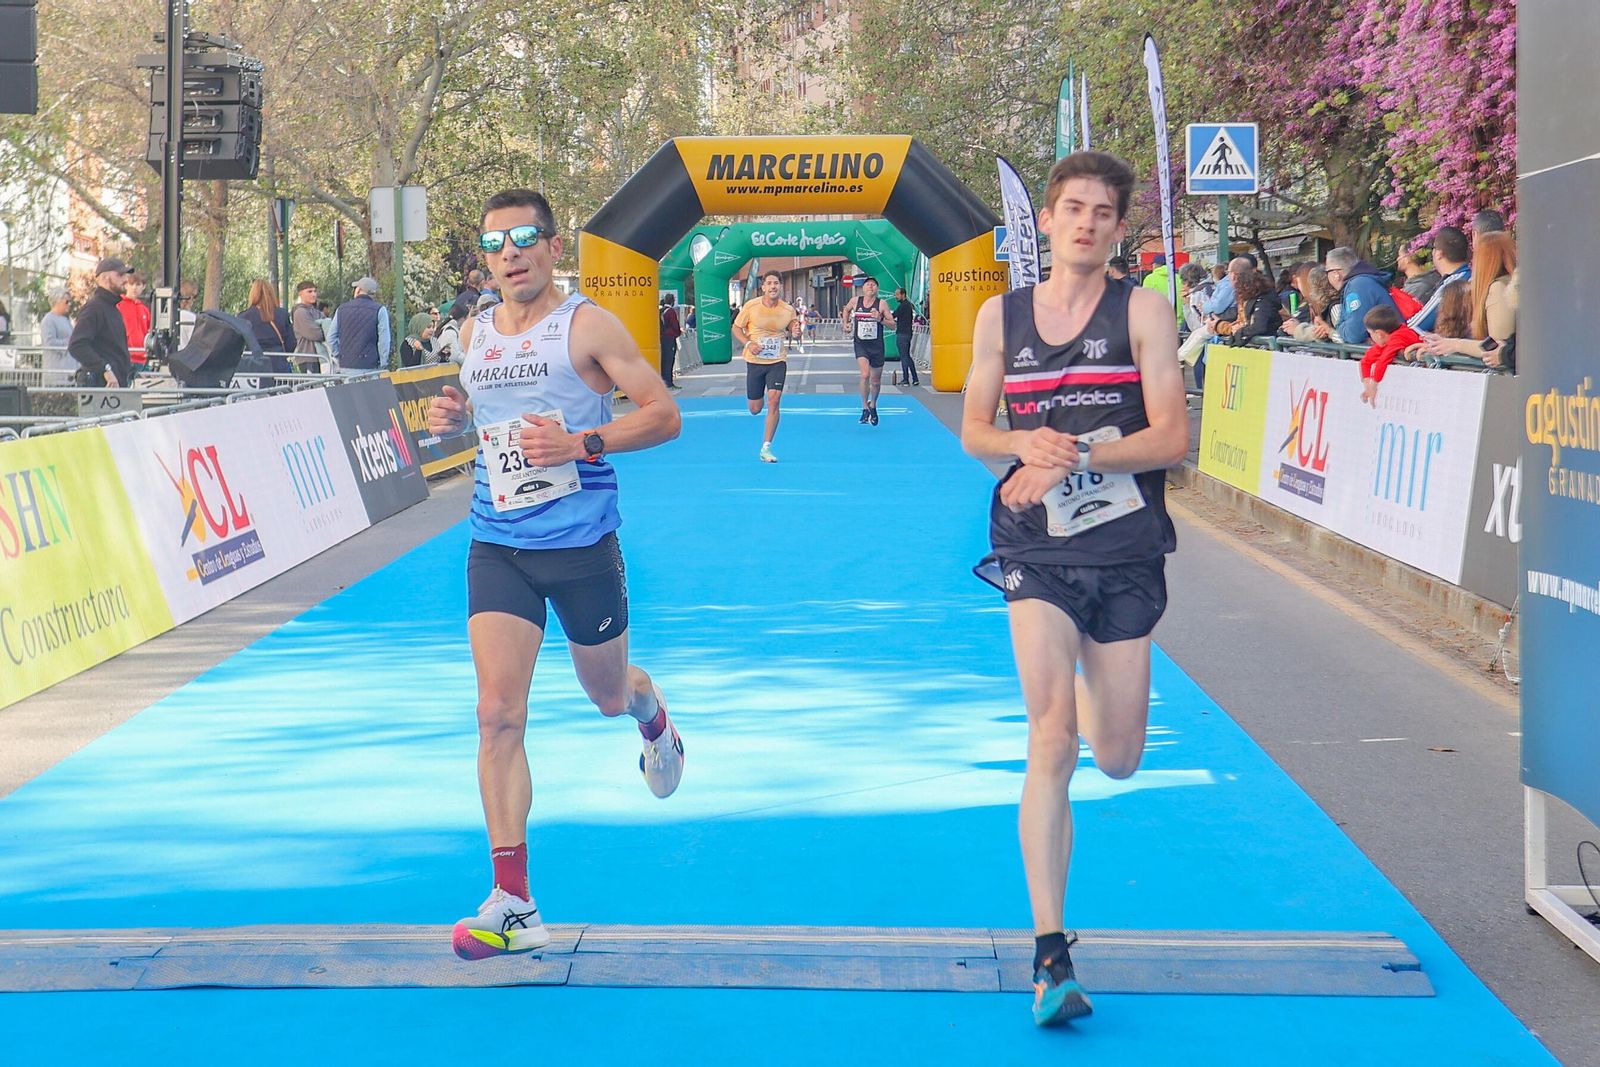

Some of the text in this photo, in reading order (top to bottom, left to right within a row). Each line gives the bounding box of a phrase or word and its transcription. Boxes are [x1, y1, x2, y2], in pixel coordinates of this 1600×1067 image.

[706, 153, 884, 181] MARCELINO
[726, 182, 863, 197] www.mpmarcelino.es
[751, 228, 846, 250] El Corte Inglés
[584, 272, 652, 292] agustinos
[938, 267, 1005, 287] agustinos
[947, 284, 998, 292] GRANADA
[470, 362, 549, 383] MARACENA
[477, 382, 493, 390] CLUB
[504, 380, 538, 388] ATLETISMO
[1209, 429, 1248, 472] Constructora
[0, 583, 131, 666] Constructora
